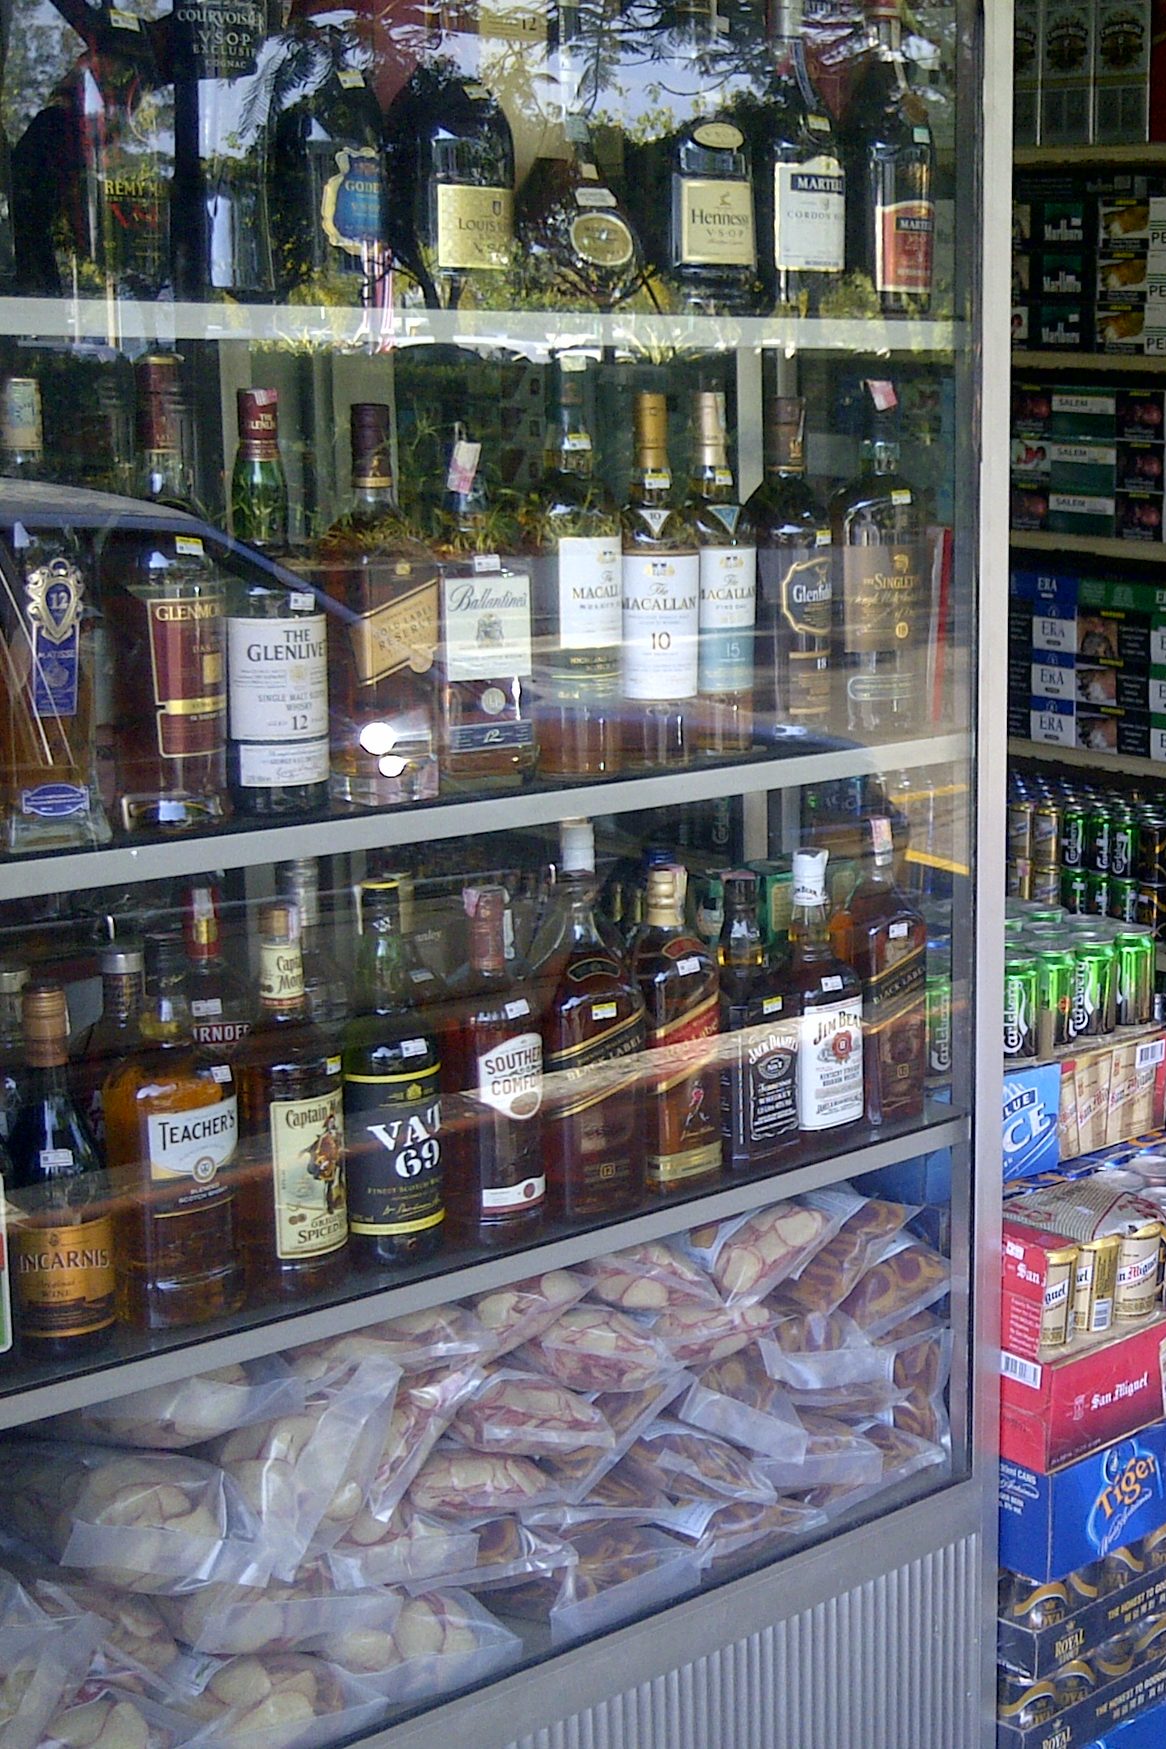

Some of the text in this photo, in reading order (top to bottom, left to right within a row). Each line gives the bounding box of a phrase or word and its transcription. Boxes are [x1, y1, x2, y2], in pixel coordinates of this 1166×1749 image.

[522, 17, 537, 31] 12
[650, 512, 661, 521] 10
[648, 582, 668, 597] The
[1037, 577, 1057, 592] ERA
[50, 592, 68, 609] 12
[283, 629, 311, 642] THE
[1041, 621, 1066, 638] ERA
[651, 632, 671, 650] 10
[726, 643, 741, 657] 15
[817, 658, 827, 669] 18
[1040, 668, 1064, 685] ERA
[292, 715, 309, 731] 12
[1039, 716, 1064, 732] ERA
[483, 729, 504, 743] 12
[813, 1016, 838, 1045] JIM
[748, 1040, 770, 1065] JACK
[286, 1105, 327, 1128] Captain
[367, 1100, 442, 1151] VAT
[158, 1108, 236, 1151] TEACHER'S
[1002, 1102, 1052, 1150] CE
[395, 1138, 441, 1178] 69
[298, 1226, 340, 1244] SPICED
[20, 1248, 110, 1273] INCARNIS
[1017, 1262, 1041, 1283] San
[1091, 1391, 1112, 1411] San
[1114, 1372, 1149, 1400] Miguel
[1098, 1454, 1157, 1520] Tiger
[1055, 1628, 1085, 1659] ROYAL
[1042, 1726, 1073, 1749] ROYAL
